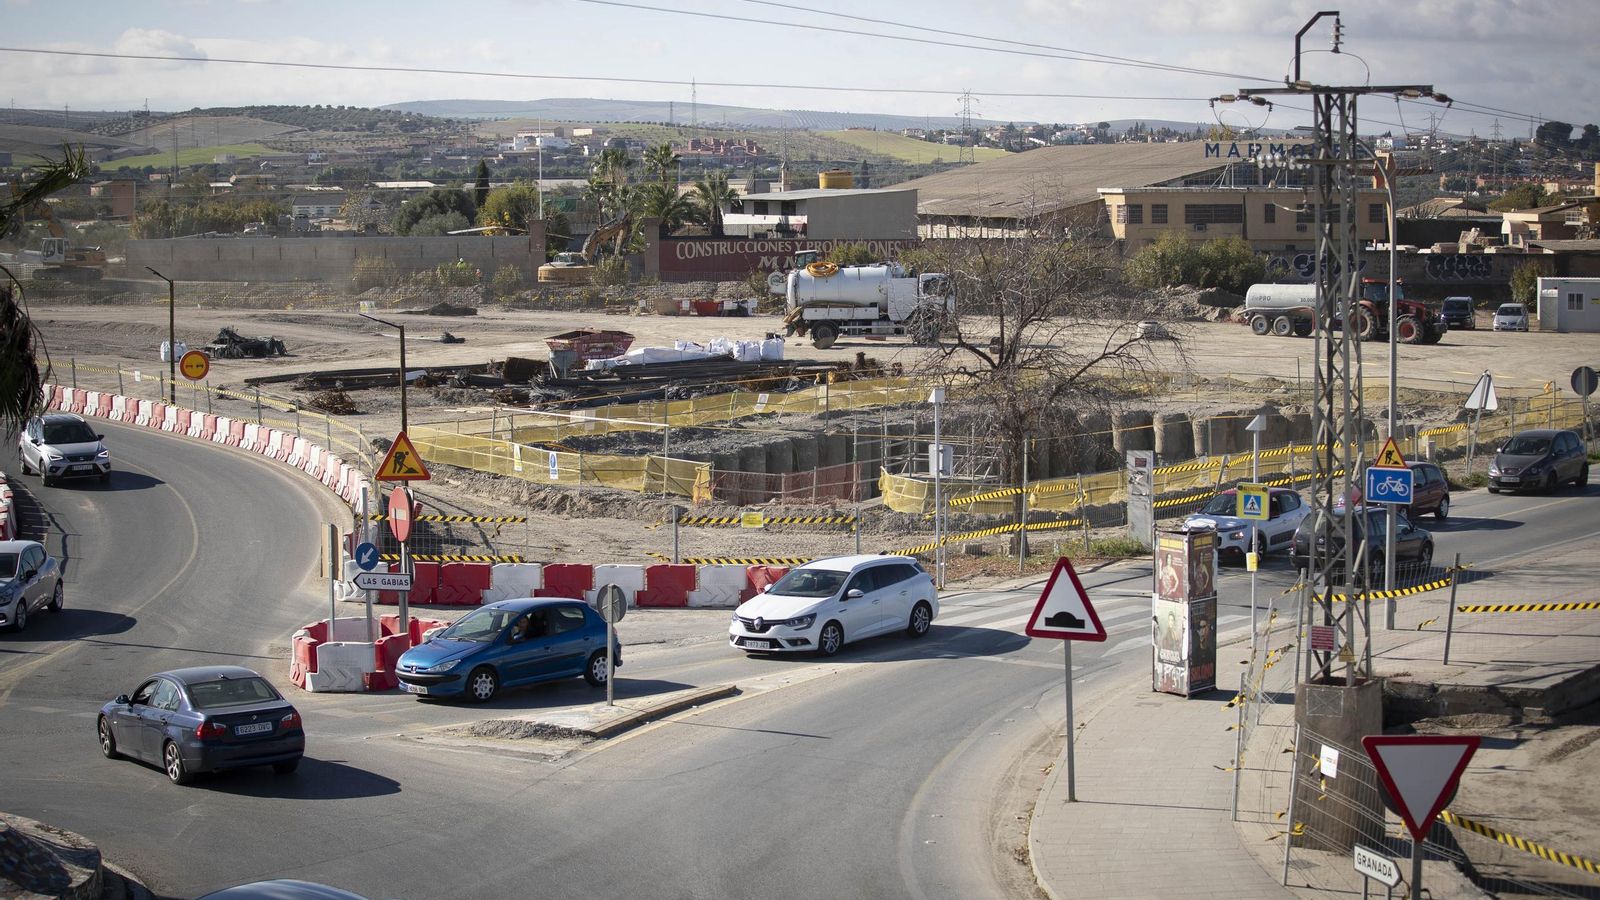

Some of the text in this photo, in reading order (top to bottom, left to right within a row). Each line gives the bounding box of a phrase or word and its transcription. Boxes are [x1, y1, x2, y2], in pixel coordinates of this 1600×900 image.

[676, 241, 791, 260] CONSTRUCCIONES
[795, 241, 804, 251] Y
[381, 578, 409, 586] GABIAS
[1356, 852, 1393, 880] GRANADA
